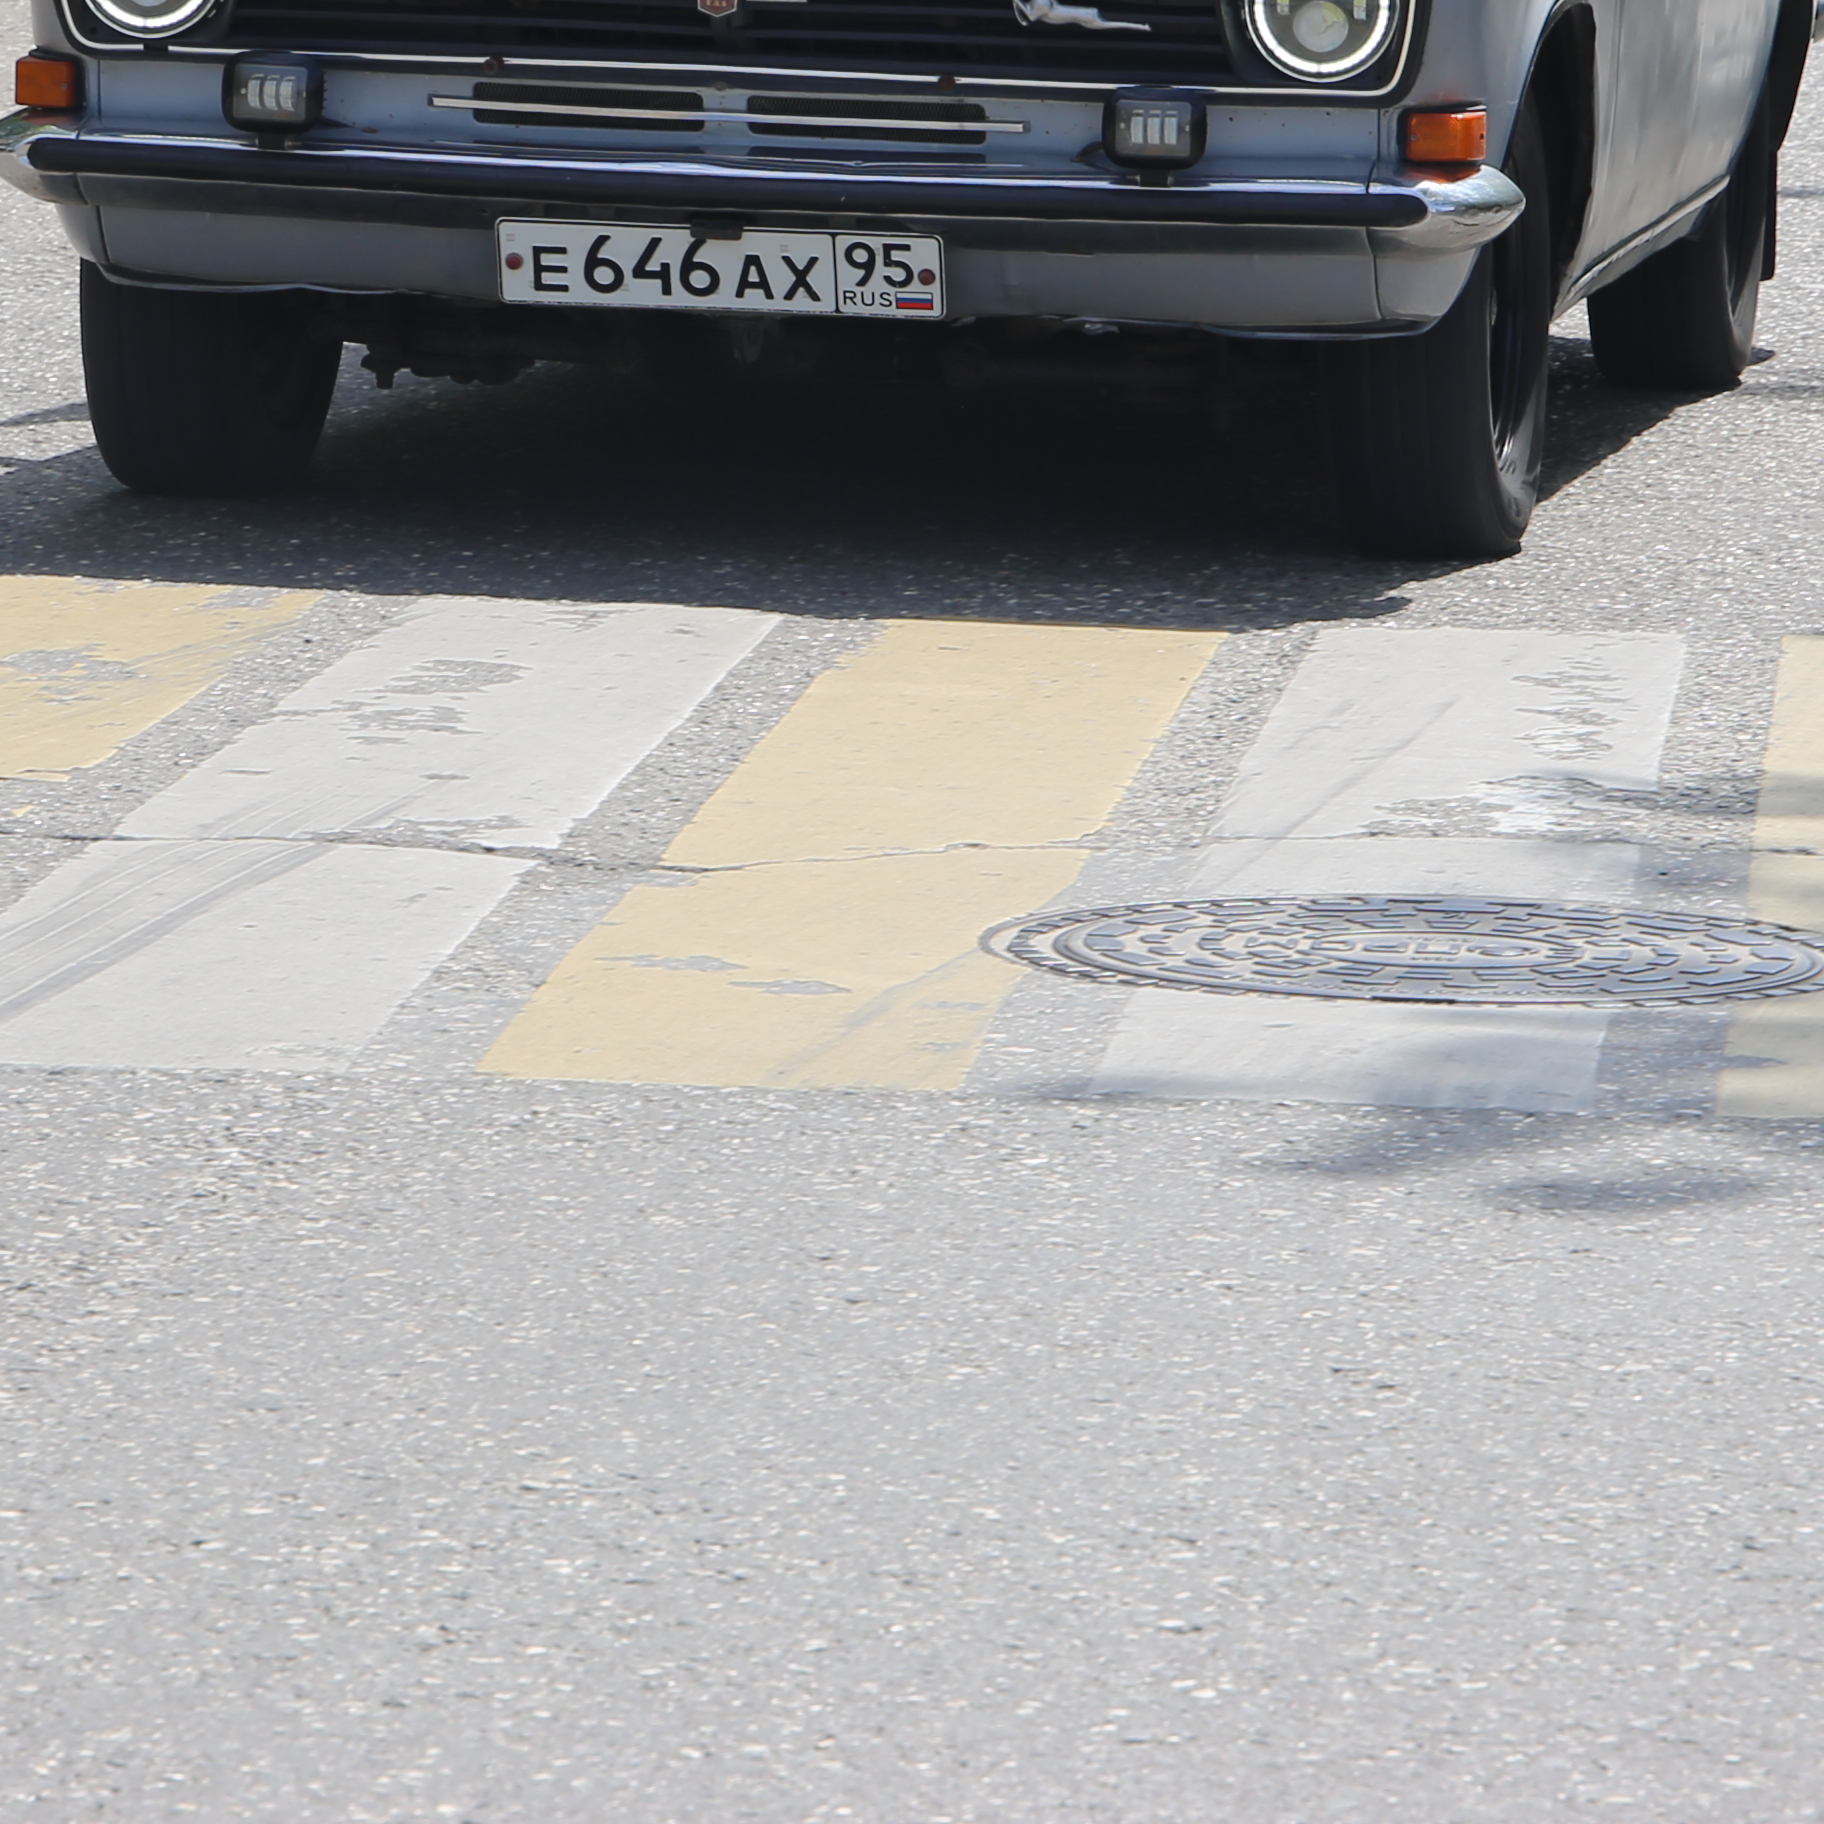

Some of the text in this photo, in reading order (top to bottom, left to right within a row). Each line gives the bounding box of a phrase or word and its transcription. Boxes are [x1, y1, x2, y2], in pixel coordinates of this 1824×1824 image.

[532, 235, 915, 302] Е646АХ 95
[843, 290, 893, 308] RUS
